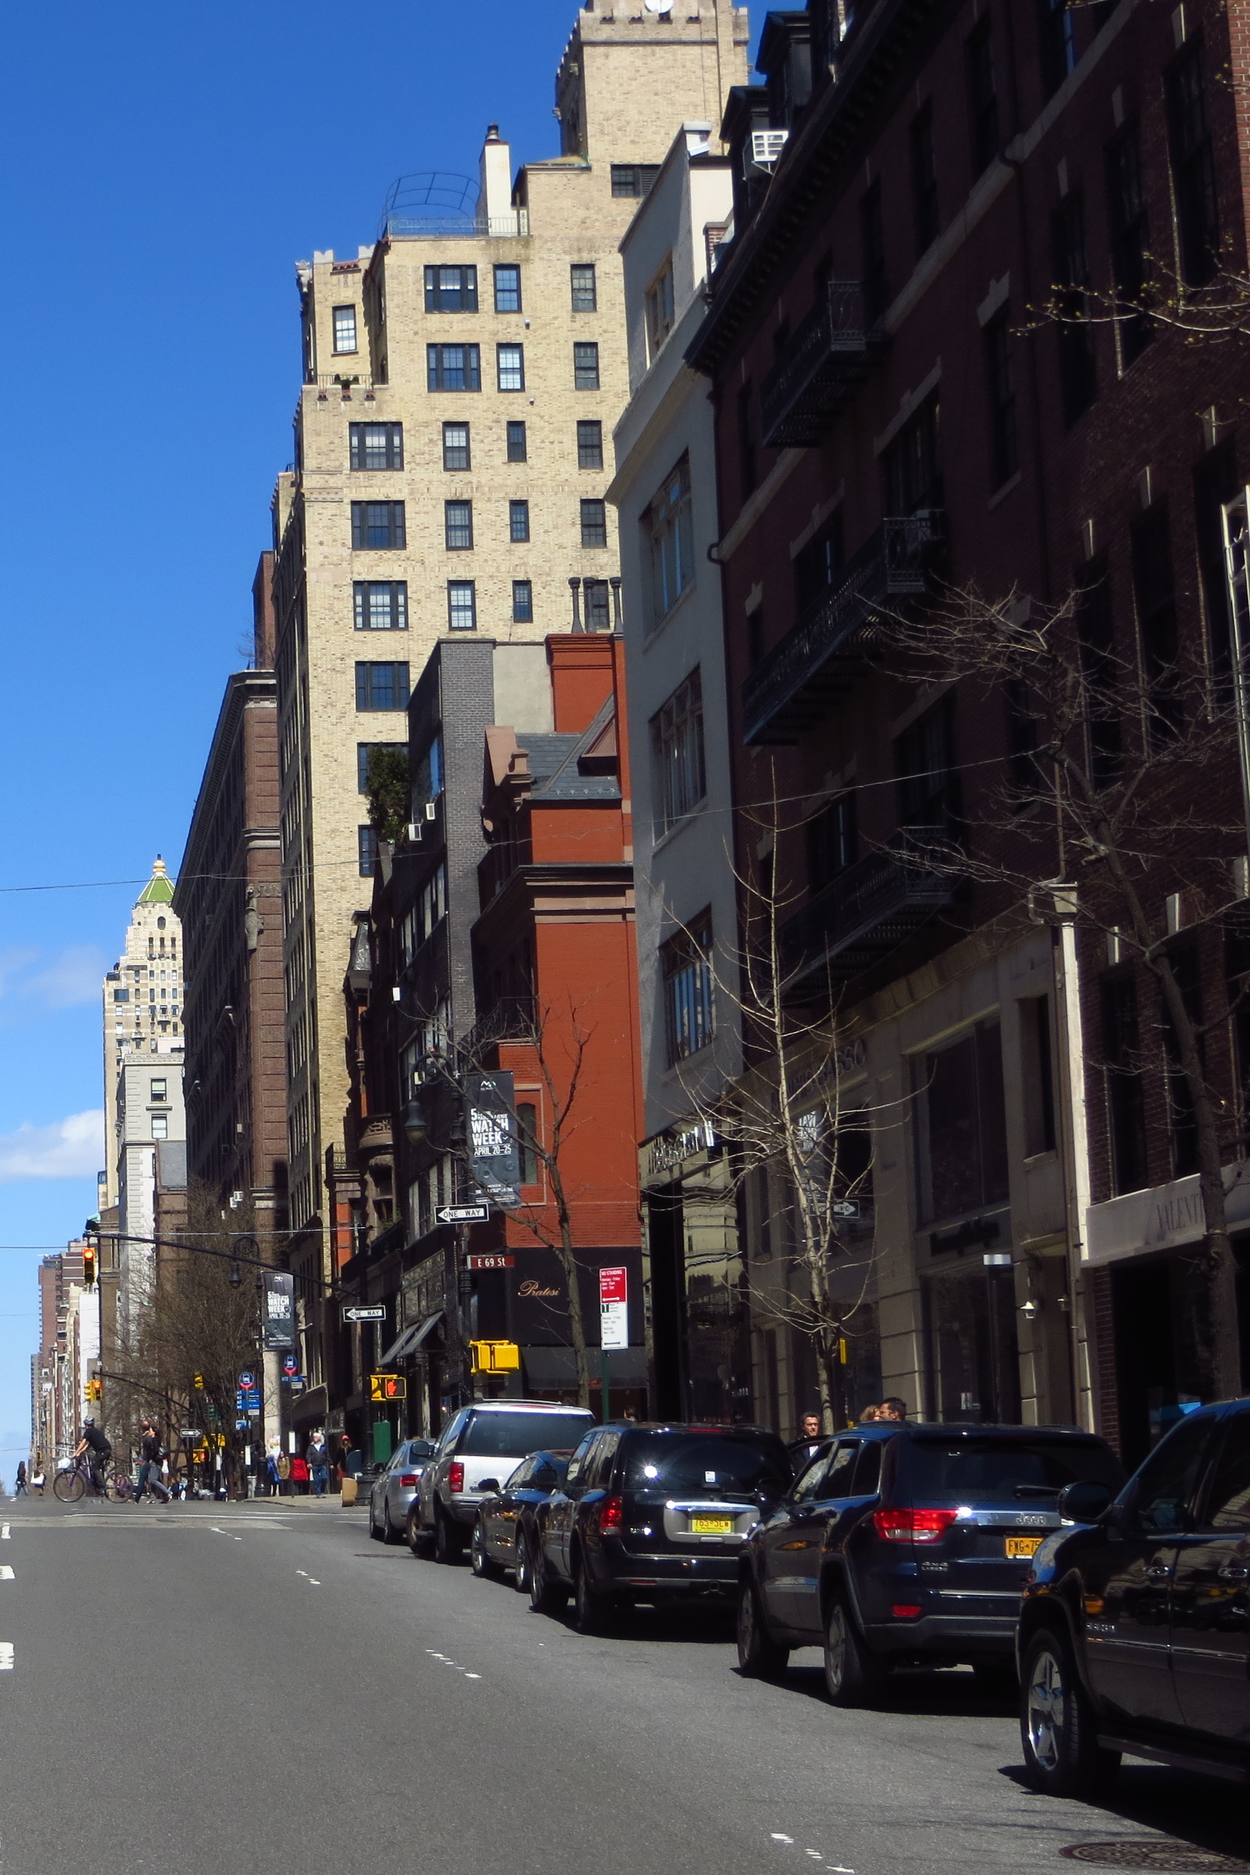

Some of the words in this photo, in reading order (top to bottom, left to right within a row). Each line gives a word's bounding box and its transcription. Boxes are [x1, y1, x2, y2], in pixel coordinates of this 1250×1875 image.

[472, 1132, 503, 1146] WEEK
[474, 1145, 491, 1156] APRIL
[478, 1259, 482, 1267] E
[485, 1258, 494, 1267] 69
[497, 1257, 506, 1266] St
[518, 1280, 560, 1297] Pratesi
[268, 1305, 285, 1313] WEEK
[1015, 1512, 1047, 1525] Jeep
